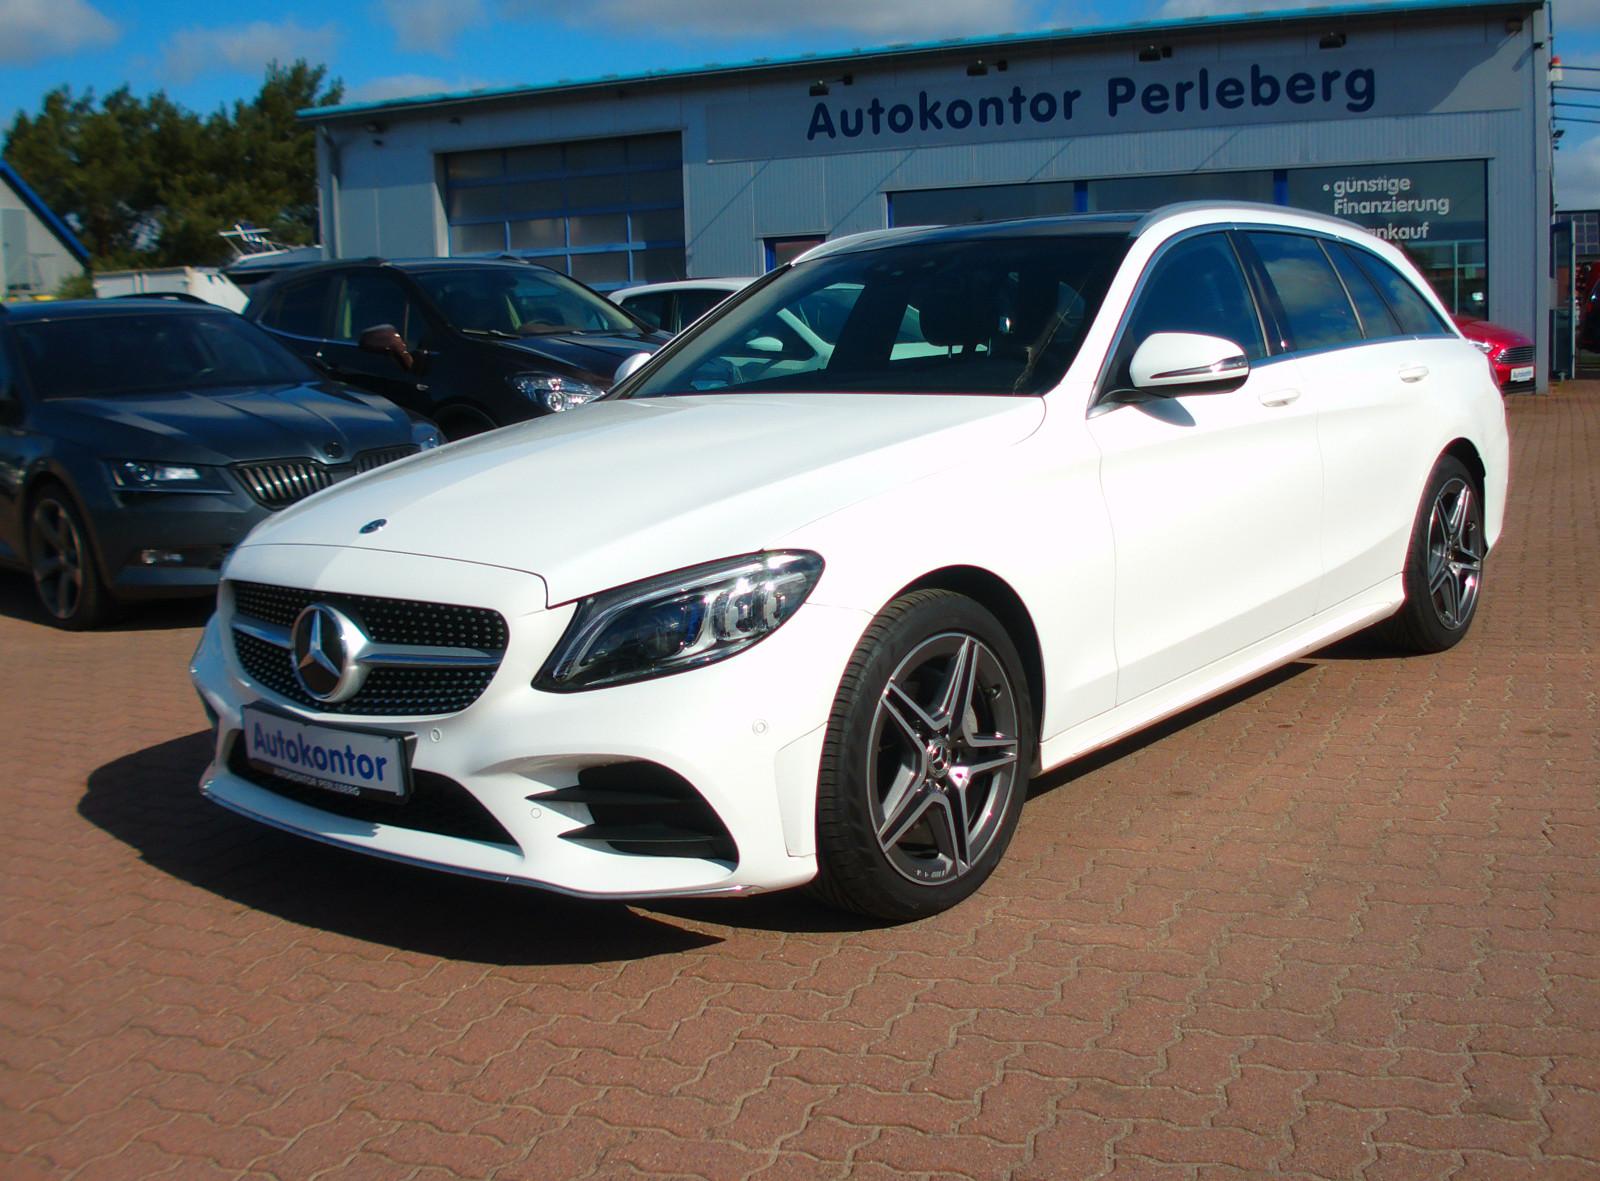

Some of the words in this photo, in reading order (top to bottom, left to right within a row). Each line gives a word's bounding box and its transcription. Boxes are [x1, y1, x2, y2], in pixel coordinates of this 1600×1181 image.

[806, 90, 1082, 142] Autokontor
[1107, 64, 1376, 117] Perleberg
[1333, 176, 1411, 198] günstige
[1333, 197, 1450, 215] Finanzierung
[254, 722, 388, 782] Autokontor
